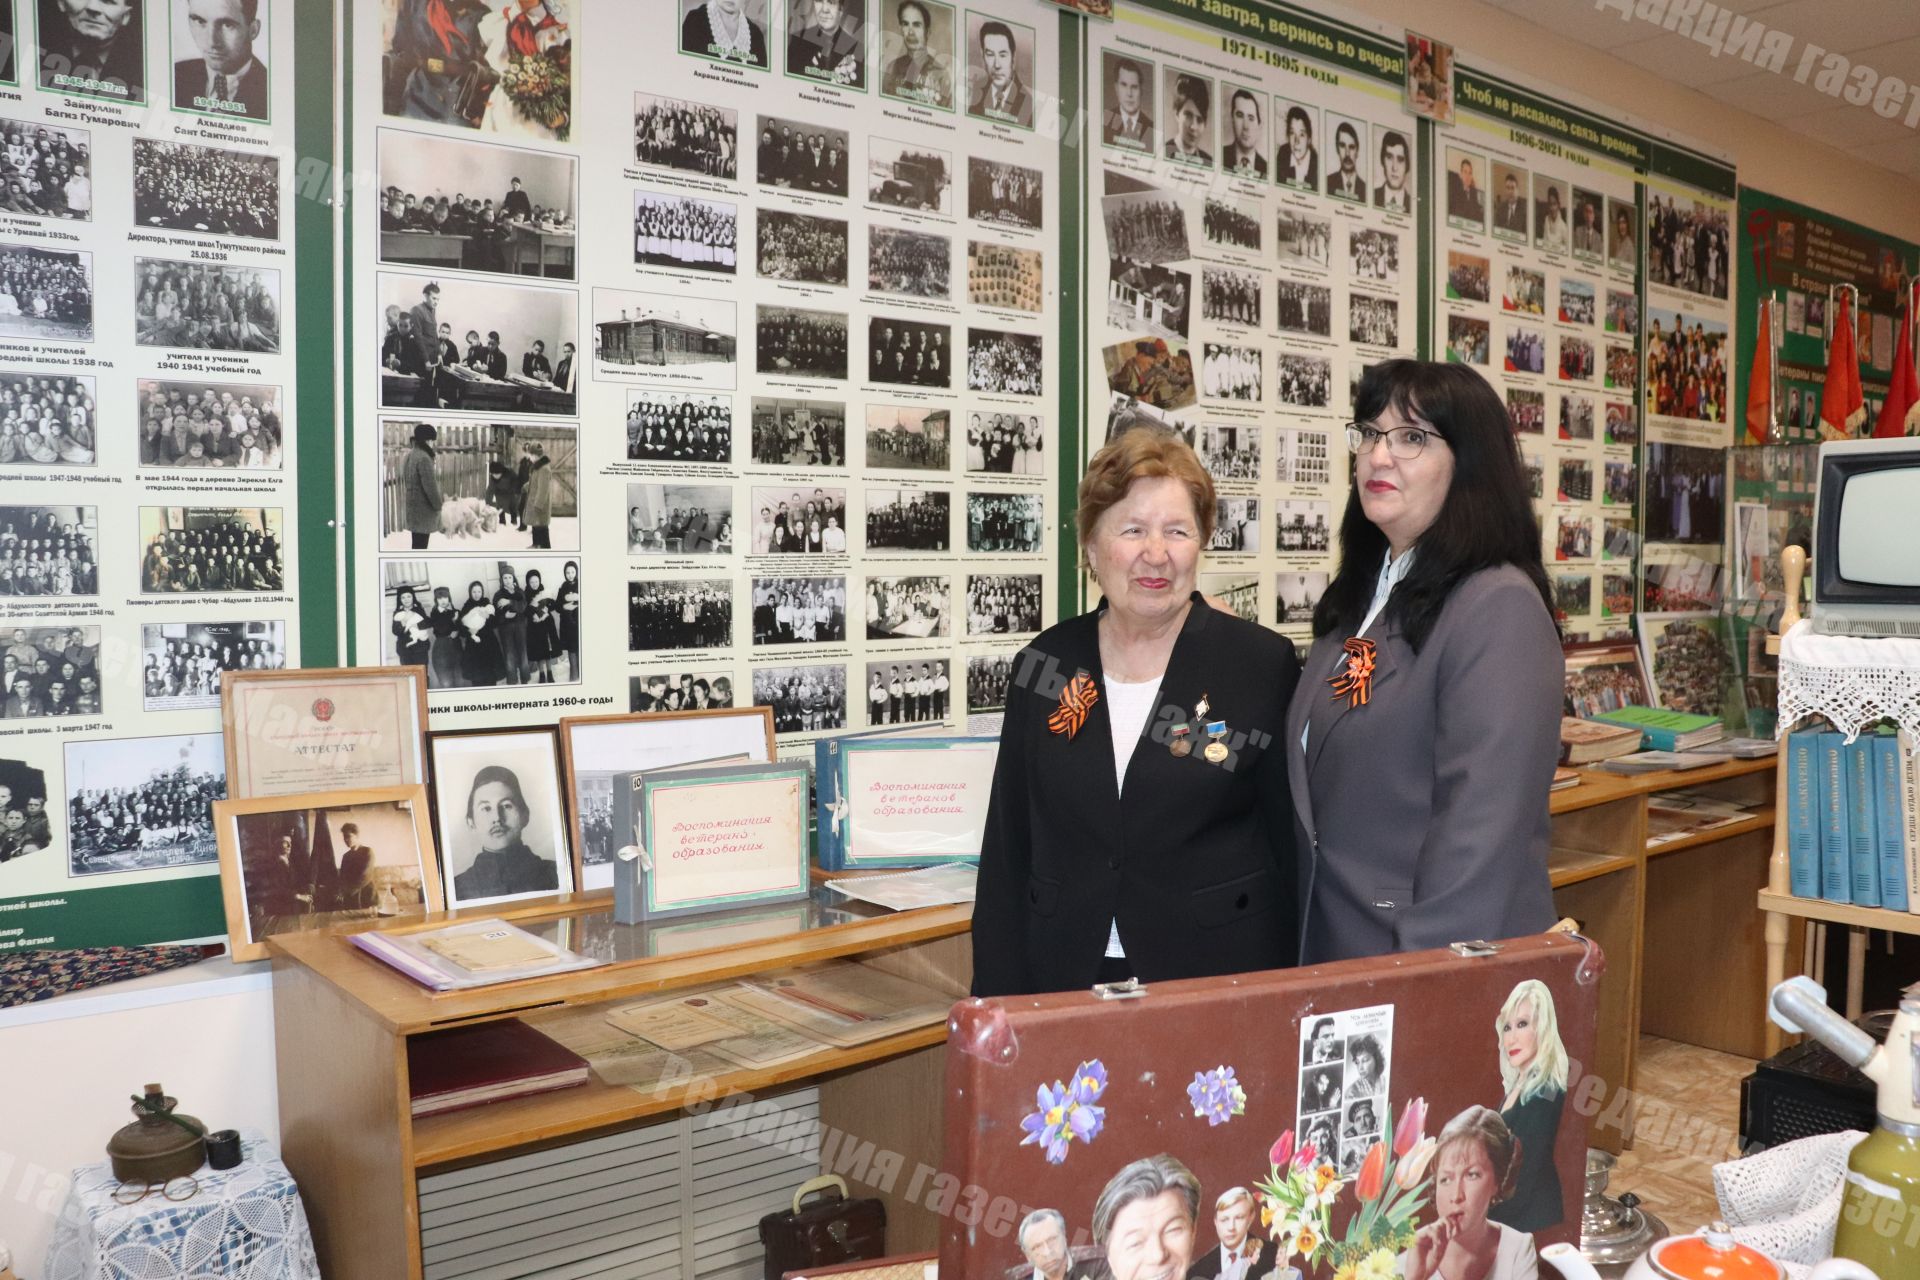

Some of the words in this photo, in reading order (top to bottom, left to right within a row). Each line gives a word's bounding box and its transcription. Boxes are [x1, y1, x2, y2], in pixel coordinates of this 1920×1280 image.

[1268, 18, 1333, 50] вернись
[1337, 39, 1355, 58] во
[1358, 49, 1405, 75] вчера!
[1220, 37, 1299, 71] 1971-1995
[1303, 65, 1339, 86] годы
[64, 98, 122, 115] Зайнуллин
[194, 96, 247, 113] 1947-1951
[1464, 81, 1491, 104] Чтоб
[1495, 95, 1510, 110] не
[1512, 99, 1568, 132] распалась
[1570, 124, 1599, 144] связь
[80, 113, 140, 129] Гумарович
[1509, 129, 1562, 158] 1996-2021
[1564, 149, 1590, 166] годы
[10, 218, 42, 228] ученики
[128, 232, 168, 246] Директора,
[169, 236, 197, 248] учителя
[197, 240, 215, 250] школ
[215, 240, 261, 255] Тумутукского
[262, 246, 286, 257] района
[191, 250, 228, 261] 25.08.1936
[41, 345, 86, 357] учителей
[36, 356, 70, 366] школы
[98, 361, 114, 370] год
[167, 353, 202, 364] учителя
[212, 355, 249, 366] ученики
[157, 362, 180, 371] 1940
[182, 363, 204, 372] 1941
[205, 364, 245, 376] учебный
[247, 367, 262, 376] год
[112, 476, 122, 484] год
[146, 483, 186, 492] открылась
[187, 484, 214, 493] первая
[254, 485, 276, 493] школа
[427, 705, 451, 714] ики
[454, 698, 549, 713] школы-интерната
[552, 696, 586, 707] 1960-е
[588, 695, 613, 706] годы
[62, 724, 83, 734] марта
[84, 723, 101, 732] 1947
[102, 723, 113, 731] год
[294, 743, 356, 755] АТТЕСТАТ
[634, 778, 642, 789] 10
[869, 781, 967, 793] Воспоминания
[880, 793, 957, 806] ветеранов
[873, 804, 965, 817] образования
[672, 816, 772, 833] Воспоминания
[672, 843, 764, 861] образования
[29, 898, 68, 909] школы.
[17, 936, 54, 948] Фагиля
